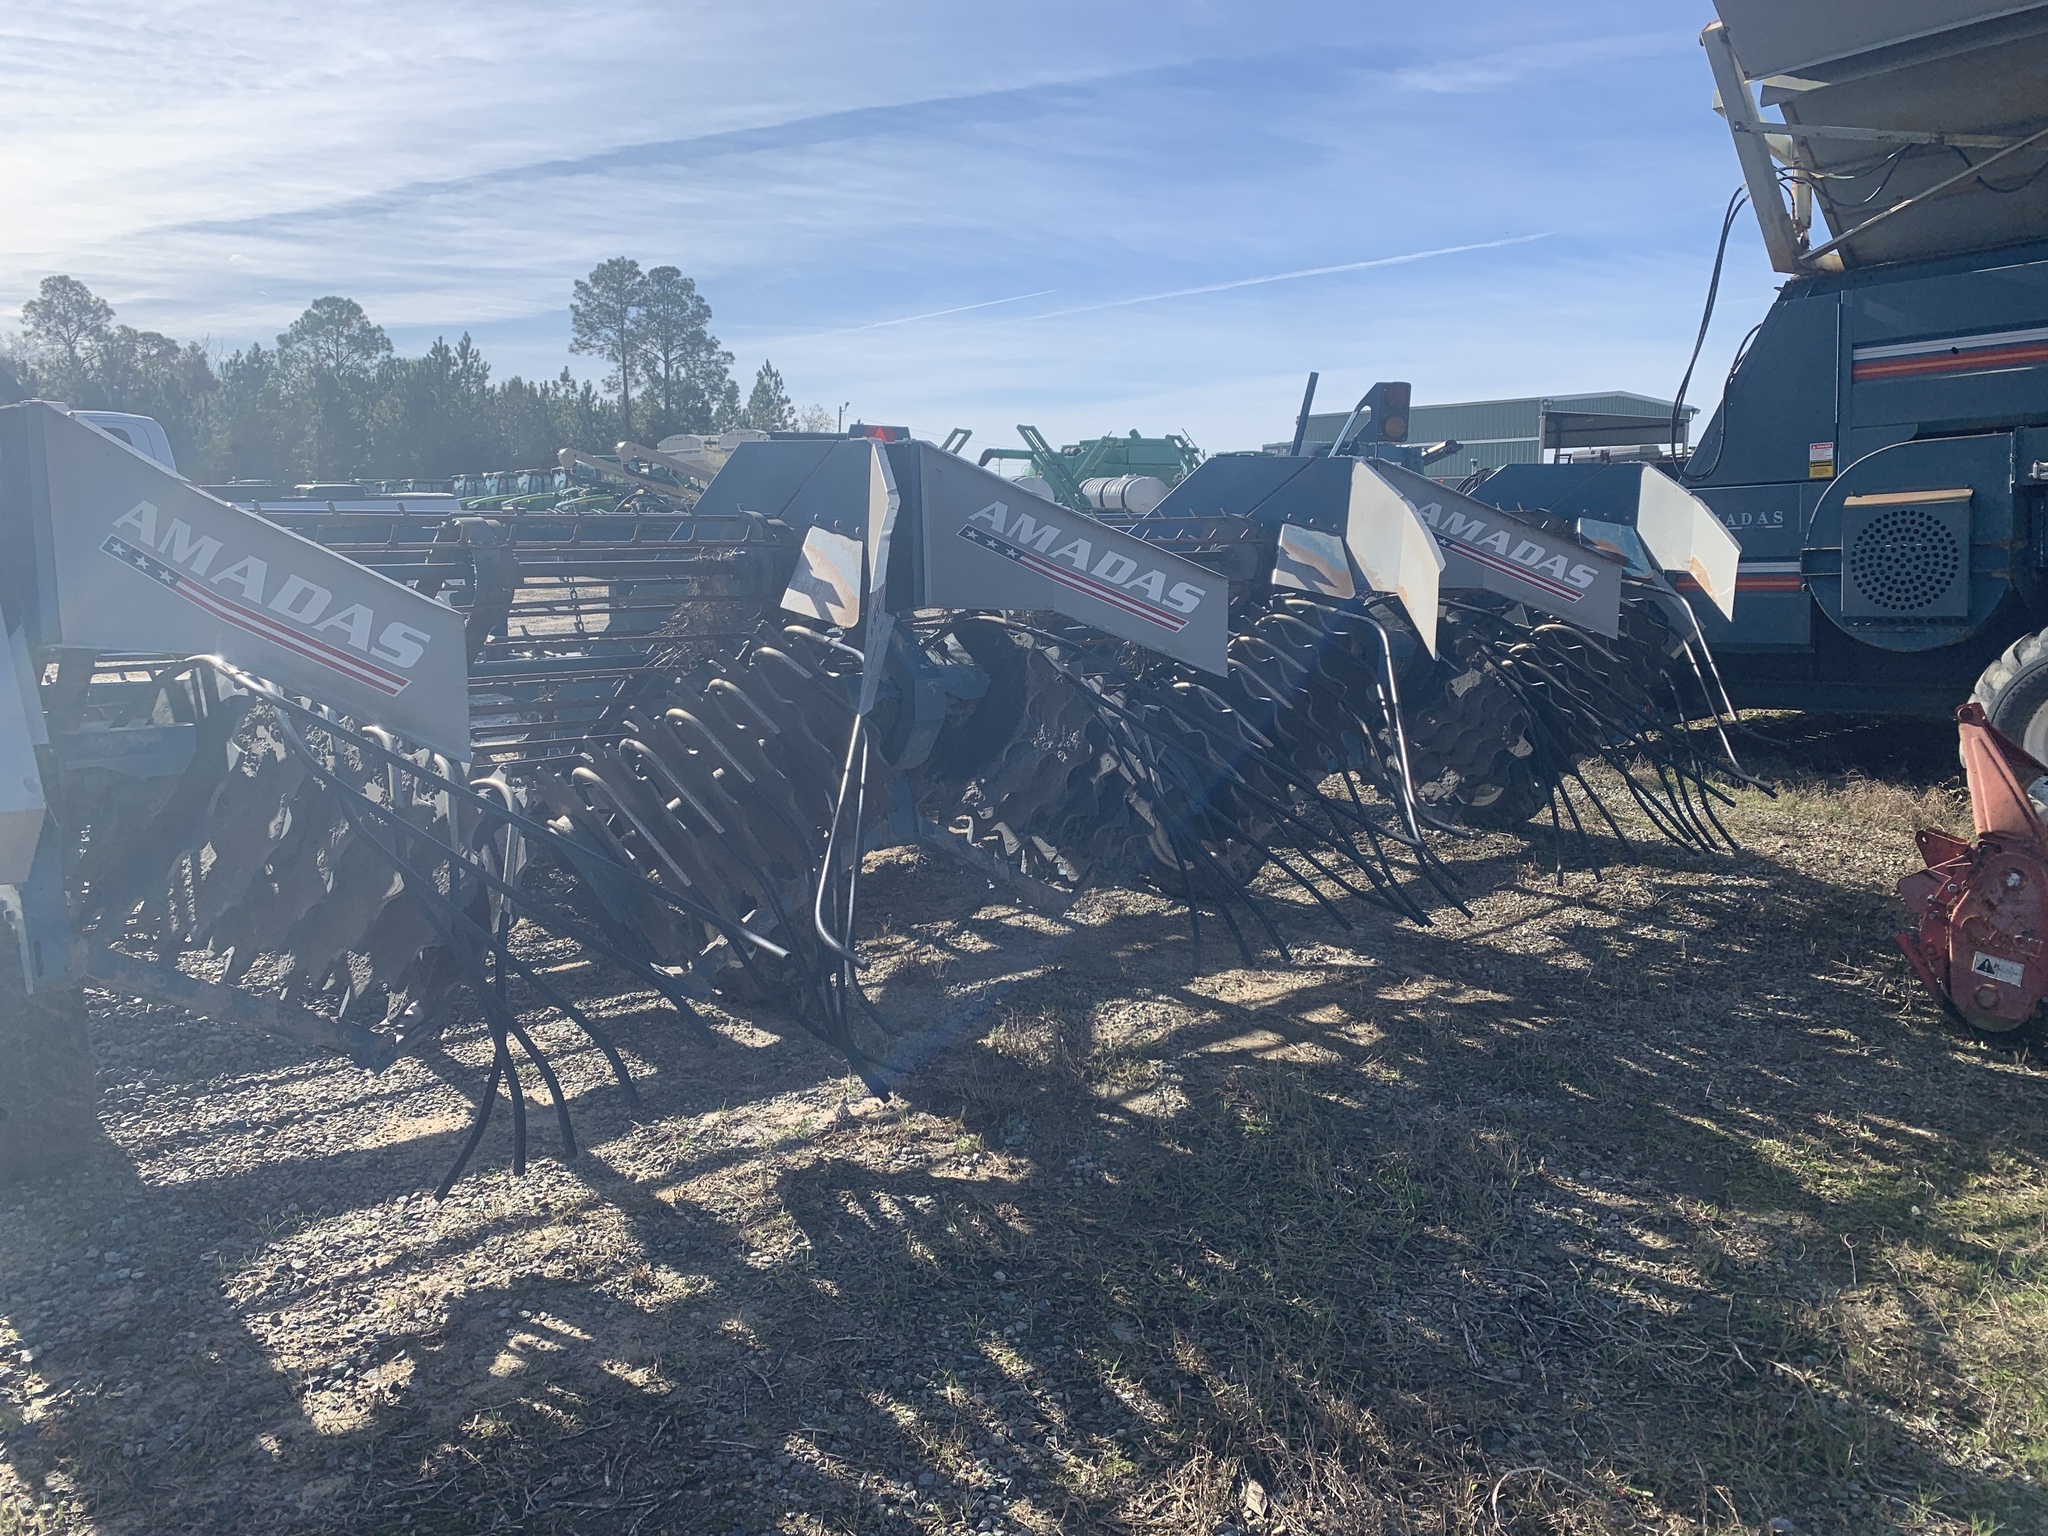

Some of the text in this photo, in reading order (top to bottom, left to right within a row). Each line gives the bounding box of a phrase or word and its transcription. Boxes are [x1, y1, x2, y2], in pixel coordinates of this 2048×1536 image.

[111, 499, 431, 669] AMADAS
[968, 500, 1207, 614] AMADAS
[1417, 501, 1600, 589] AMADAS
